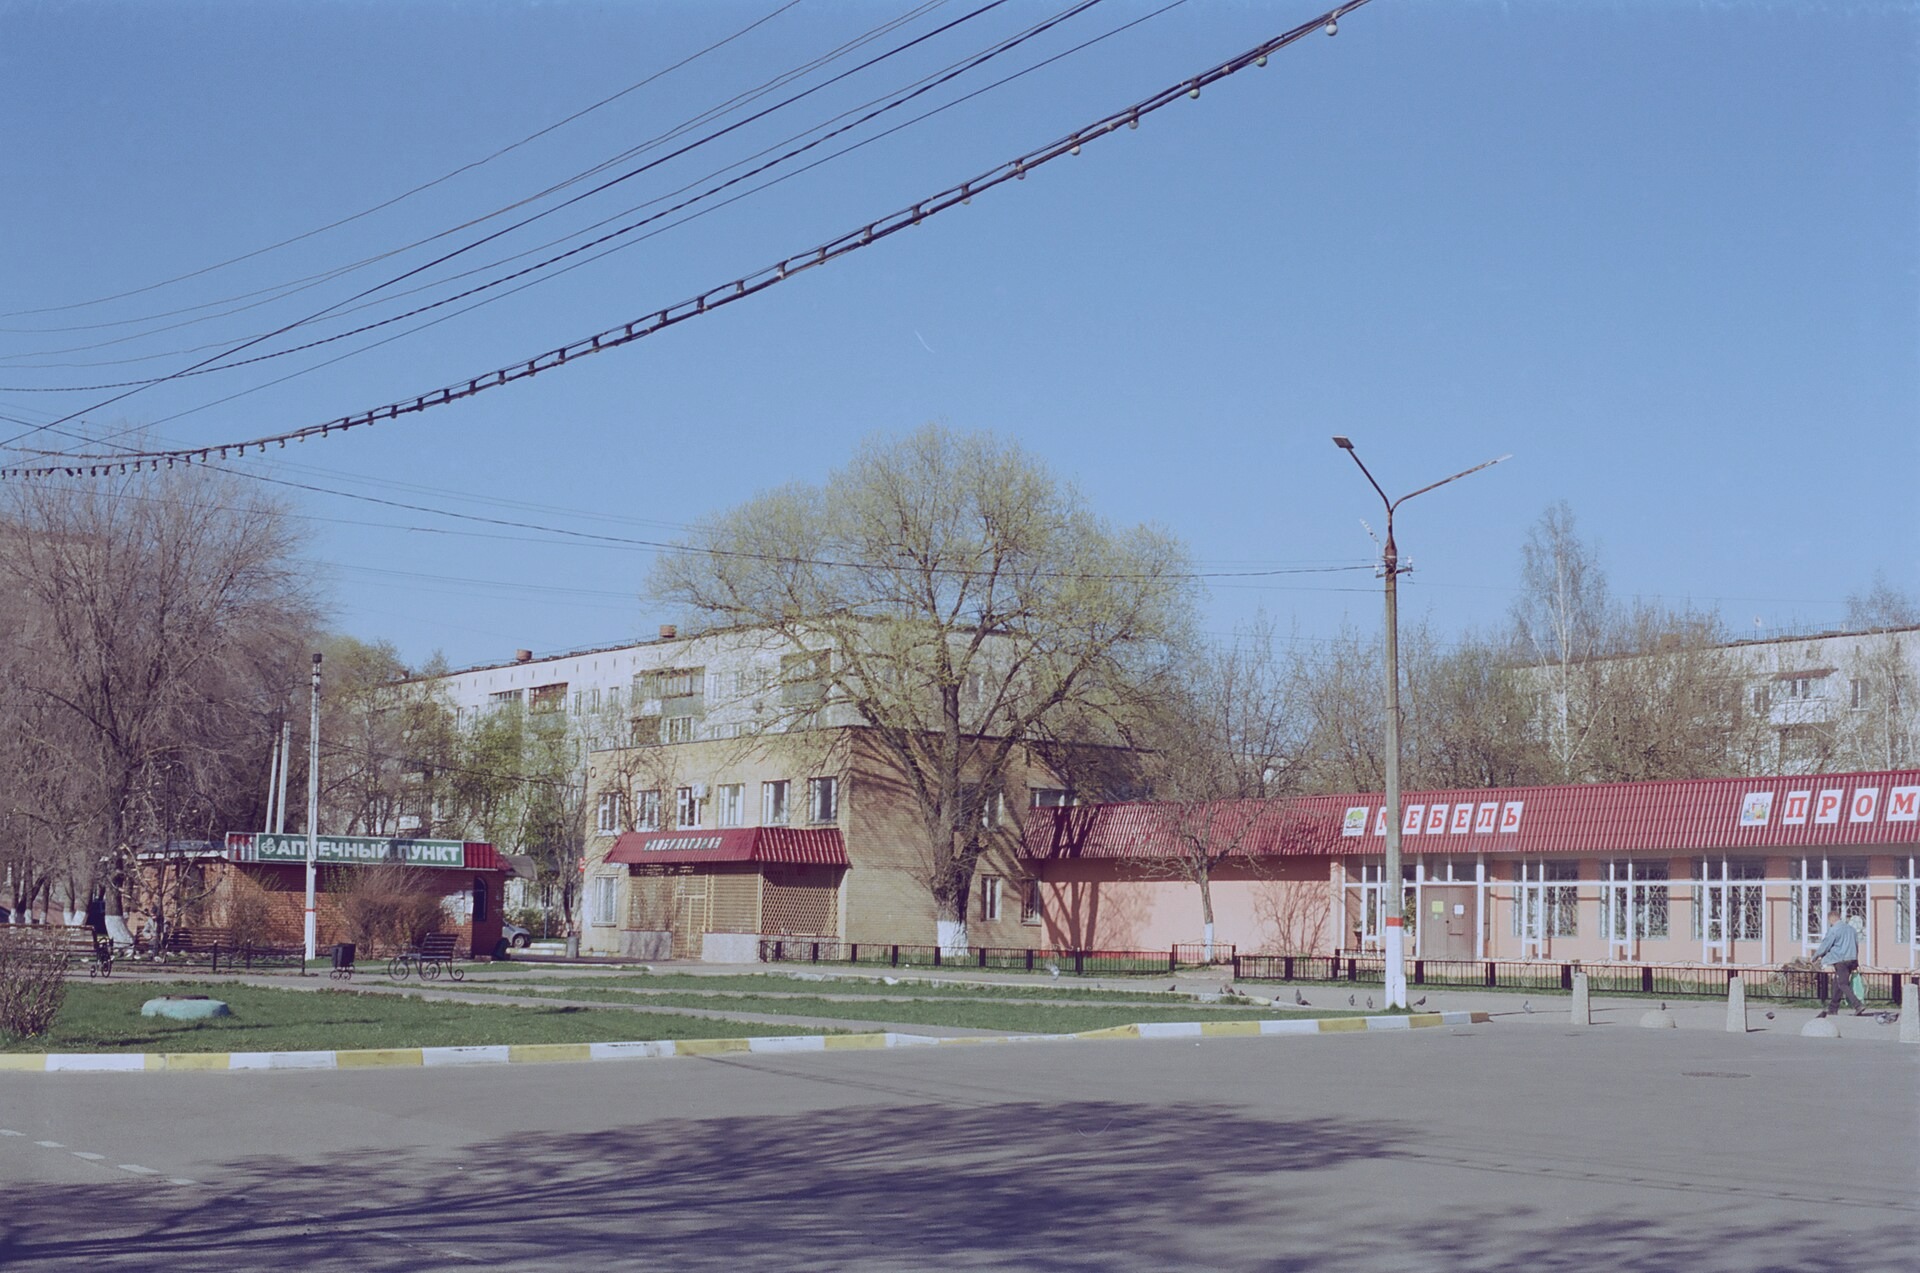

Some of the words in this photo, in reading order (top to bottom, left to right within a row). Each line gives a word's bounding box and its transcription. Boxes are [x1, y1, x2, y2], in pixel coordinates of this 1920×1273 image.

[1786, 792, 1917, 818] ПРОМ
[276, 840, 391, 859] АПЕЧНЫЙ
[397, 844, 460, 862] ПУНКТ
